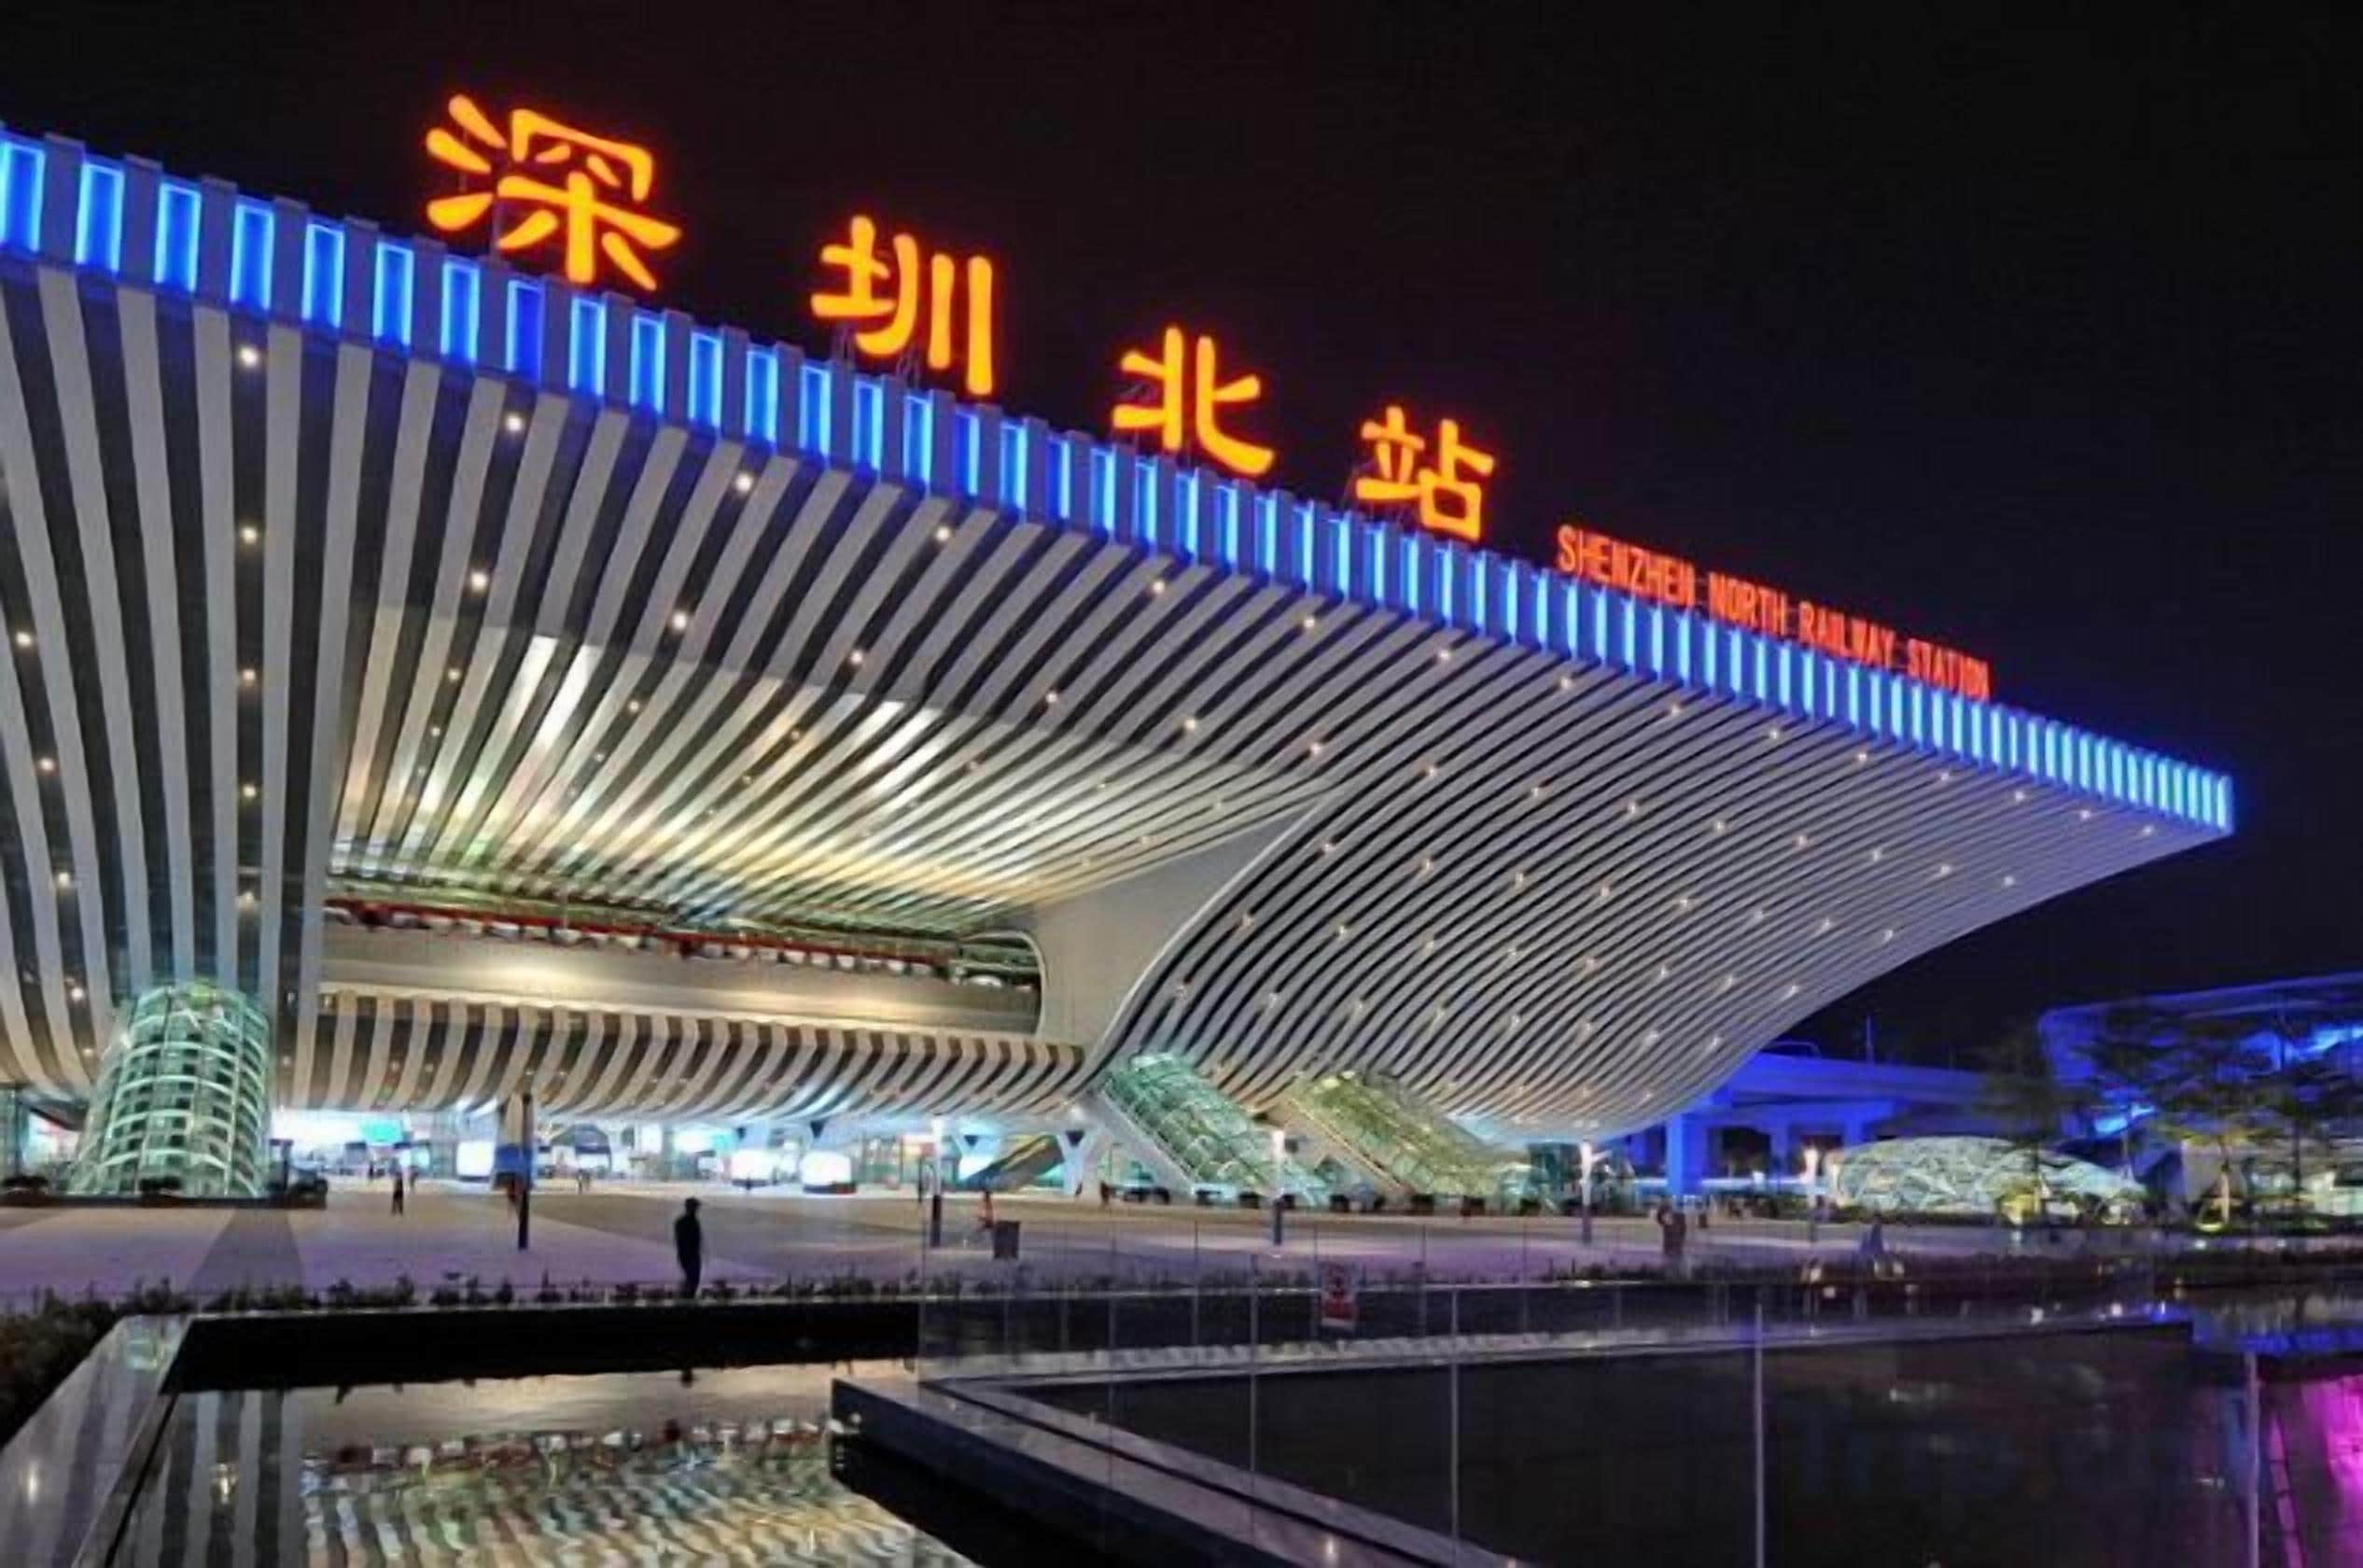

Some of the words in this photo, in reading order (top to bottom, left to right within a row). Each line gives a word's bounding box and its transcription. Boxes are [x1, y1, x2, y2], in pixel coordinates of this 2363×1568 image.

[425, 94, 1495, 540] 深圳北站
[1558, 525, 1696, 608] SHENZHEN
[1708, 571, 1787, 636] NORTH
[1798, 600, 1895, 669] RAILWAY
[1908, 637, 1991, 703] STATION
